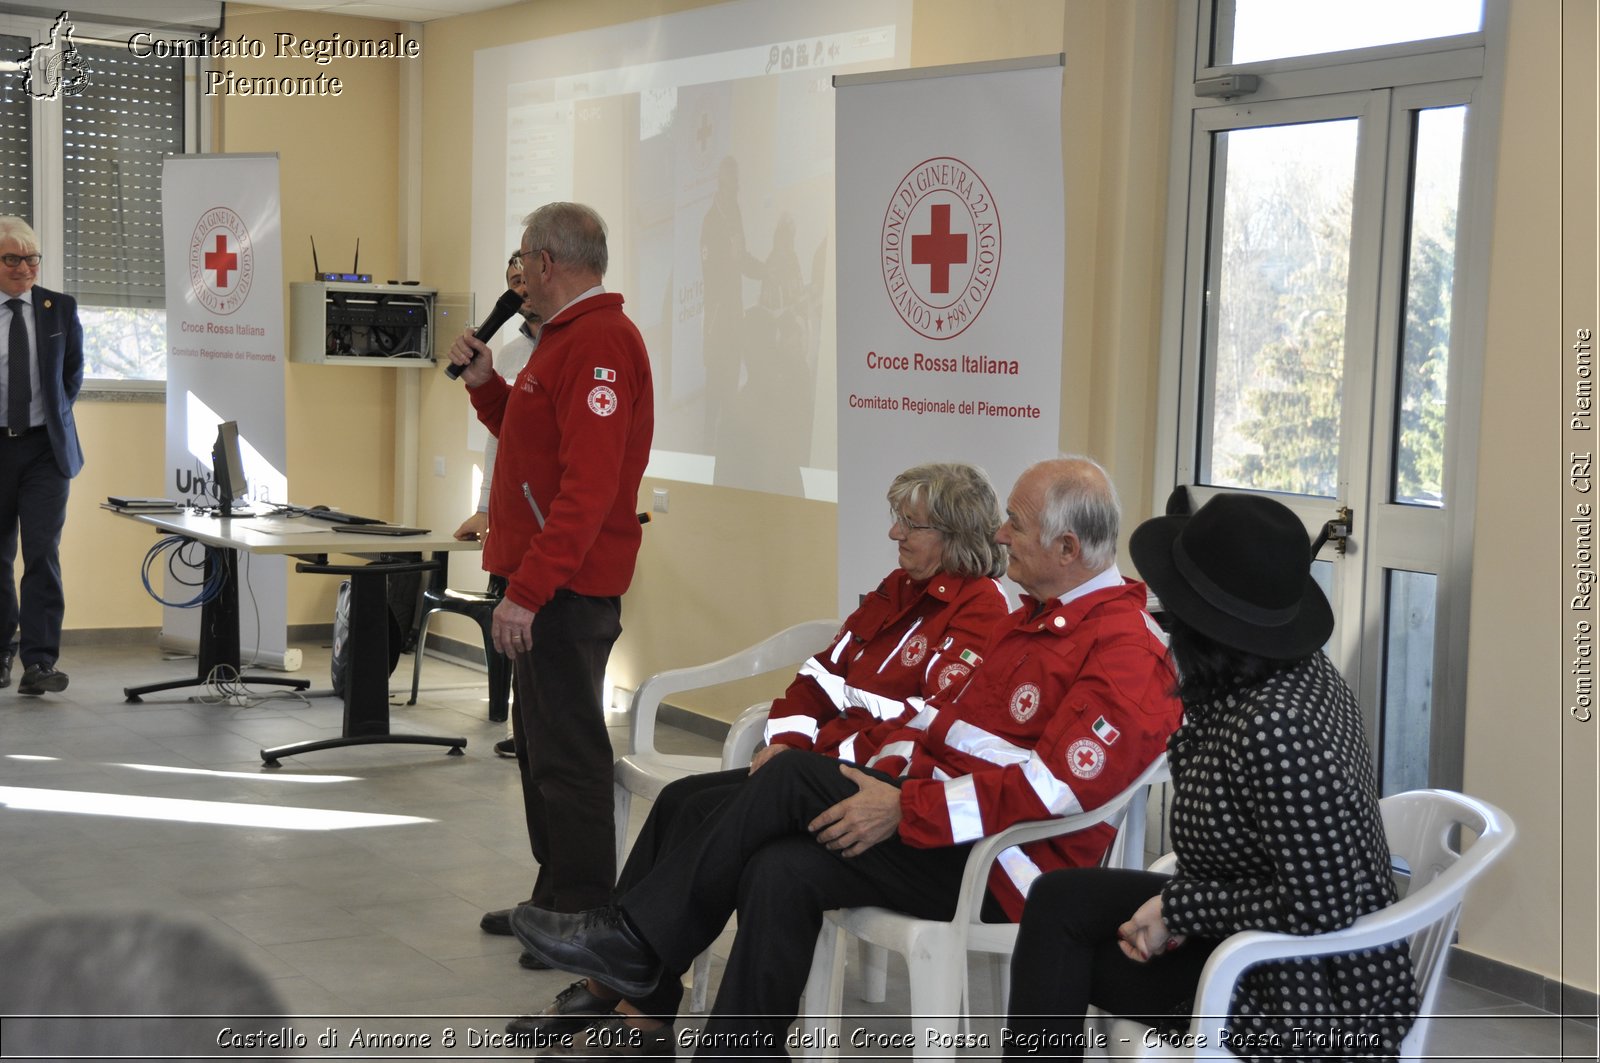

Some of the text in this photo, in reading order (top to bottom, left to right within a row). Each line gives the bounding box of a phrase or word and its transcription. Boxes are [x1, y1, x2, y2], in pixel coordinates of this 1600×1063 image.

[885, 164, 996, 331] CONVENZIONE DI GINEVRA 22 AGOSTO 1864
[181, 321, 265, 336] Croce Rossa Italiana
[200, 349, 234, 360] Regionale
[235, 351, 244, 359] del
[246, 352, 276, 362] Piemonte
[866, 351, 1019, 375] Croce Rossa Italiana
[849, 394, 1041, 419] Comitato Regionale del Piemonte
